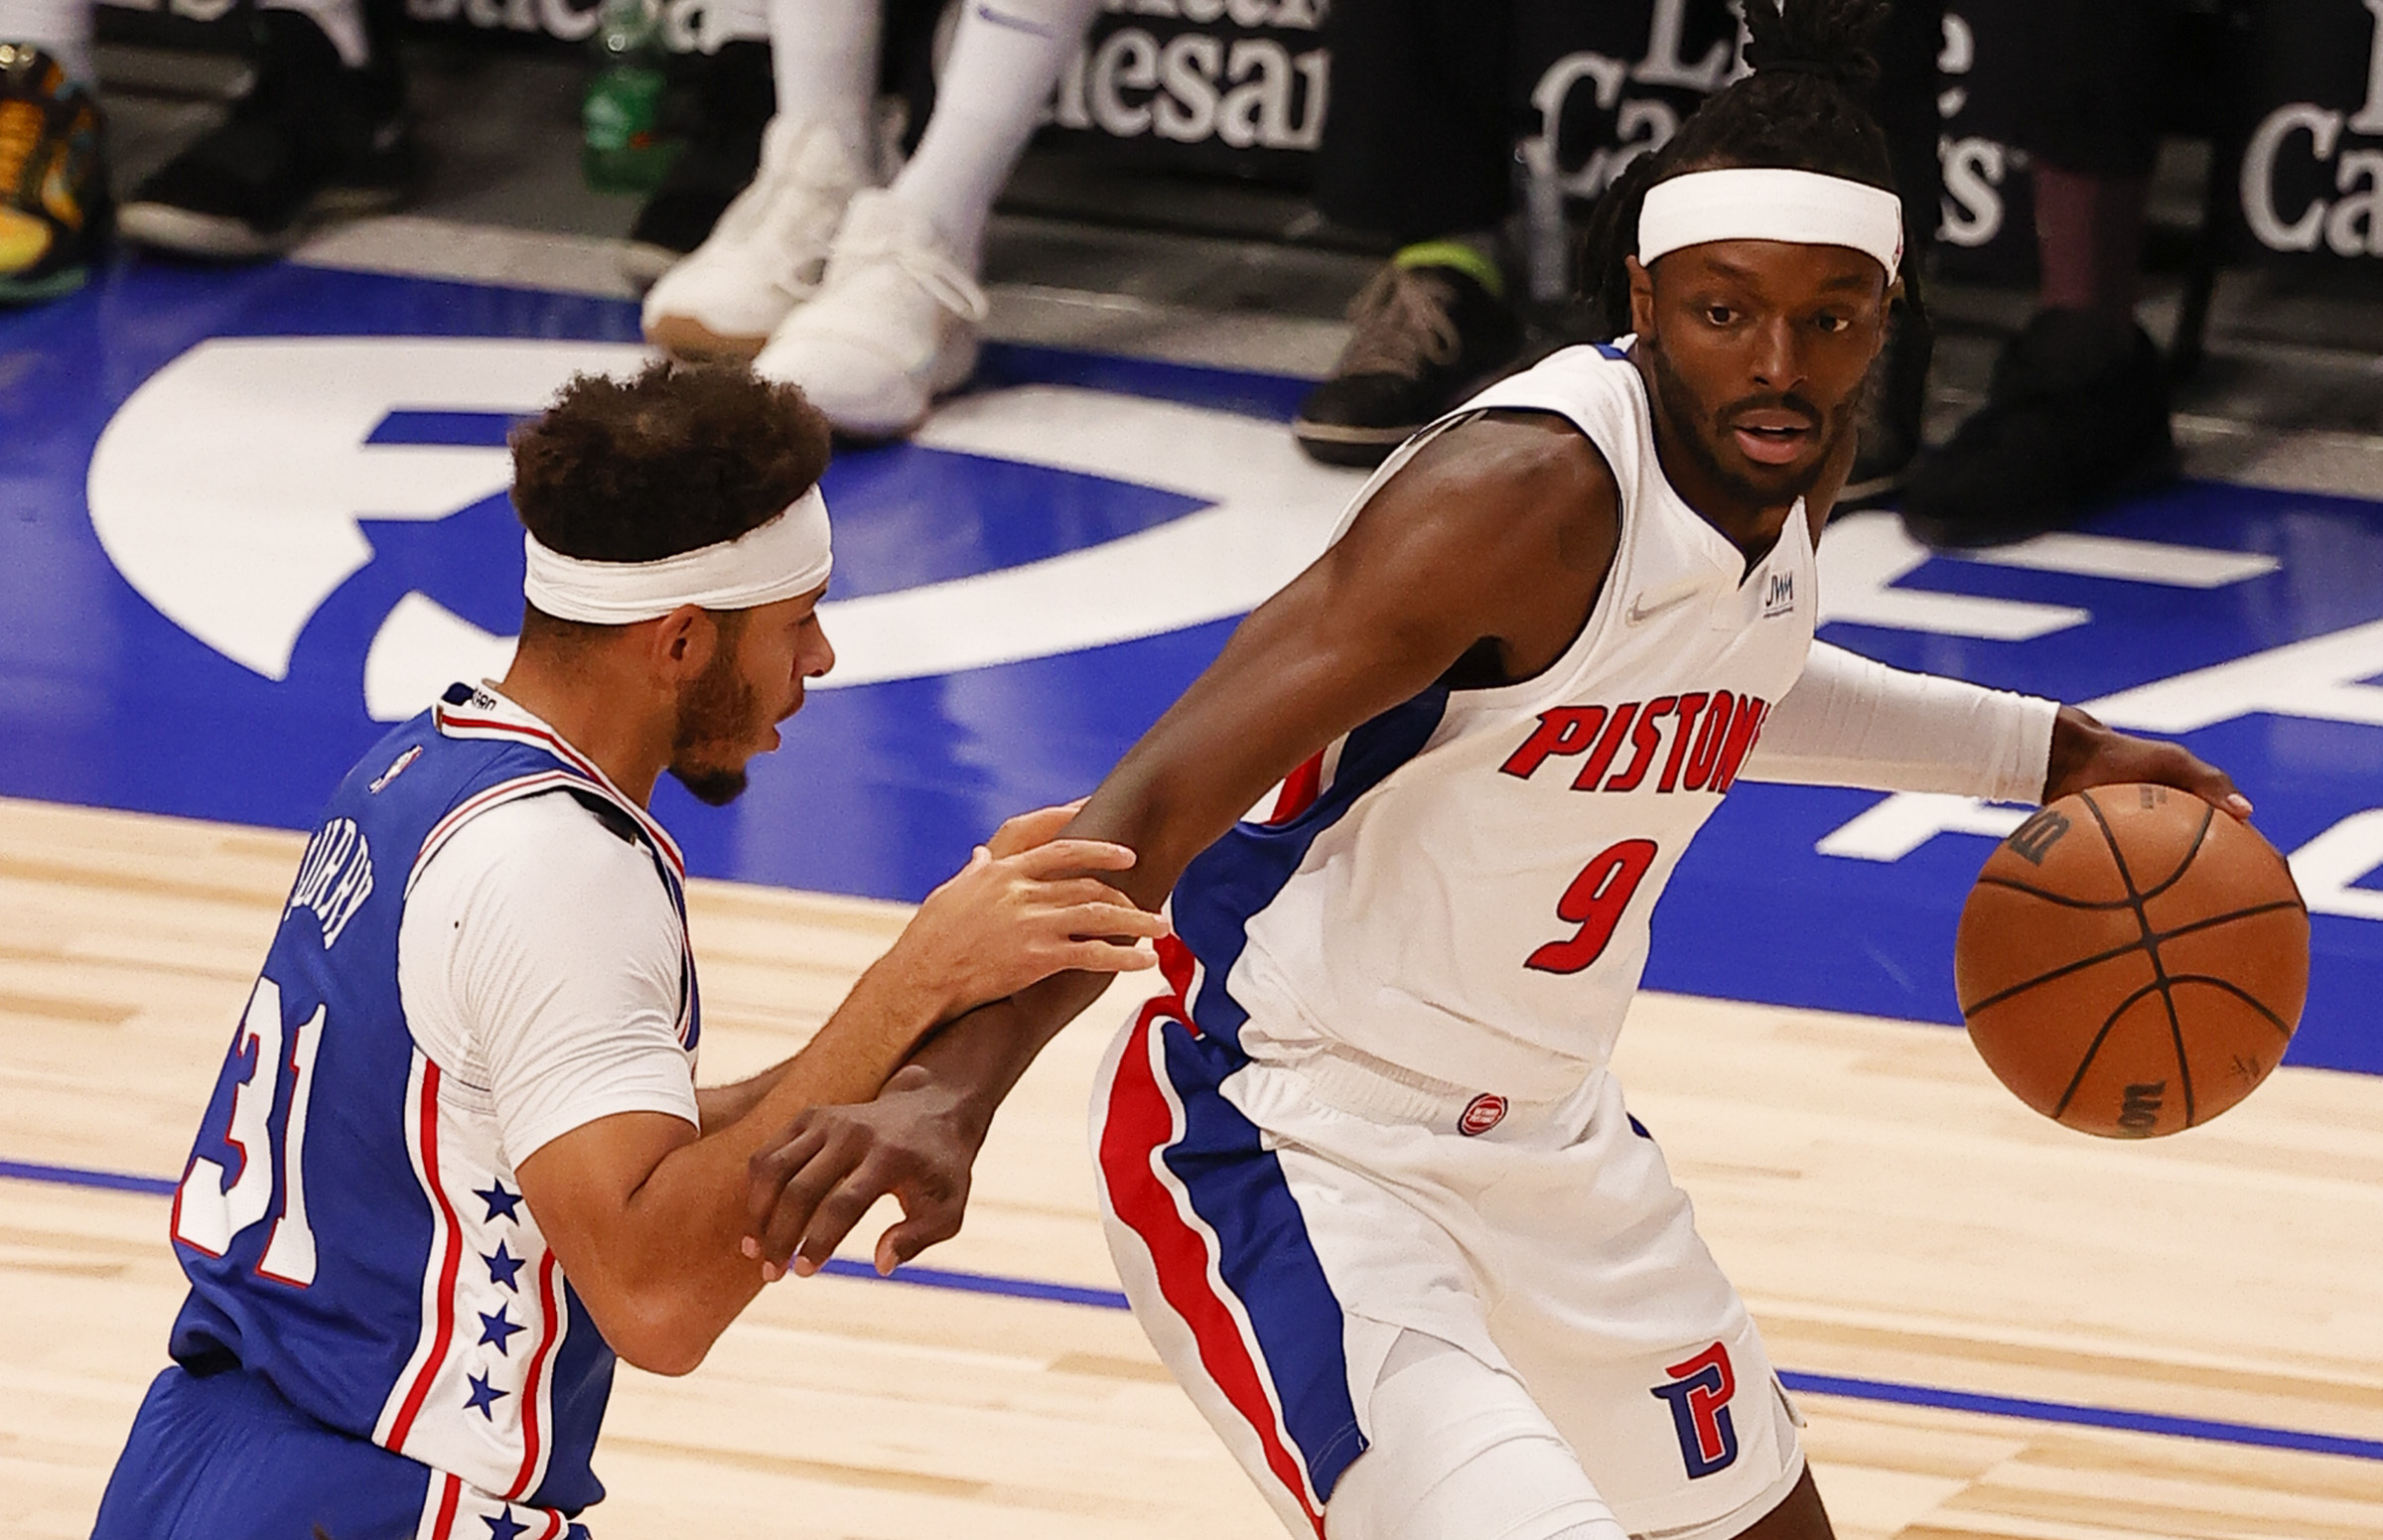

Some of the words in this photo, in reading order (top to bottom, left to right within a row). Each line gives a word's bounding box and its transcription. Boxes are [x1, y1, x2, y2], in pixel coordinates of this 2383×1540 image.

[1498, 689, 1771, 794] PISTON
[1522, 838, 1658, 975] 9
[170, 974, 327, 1289] 31
